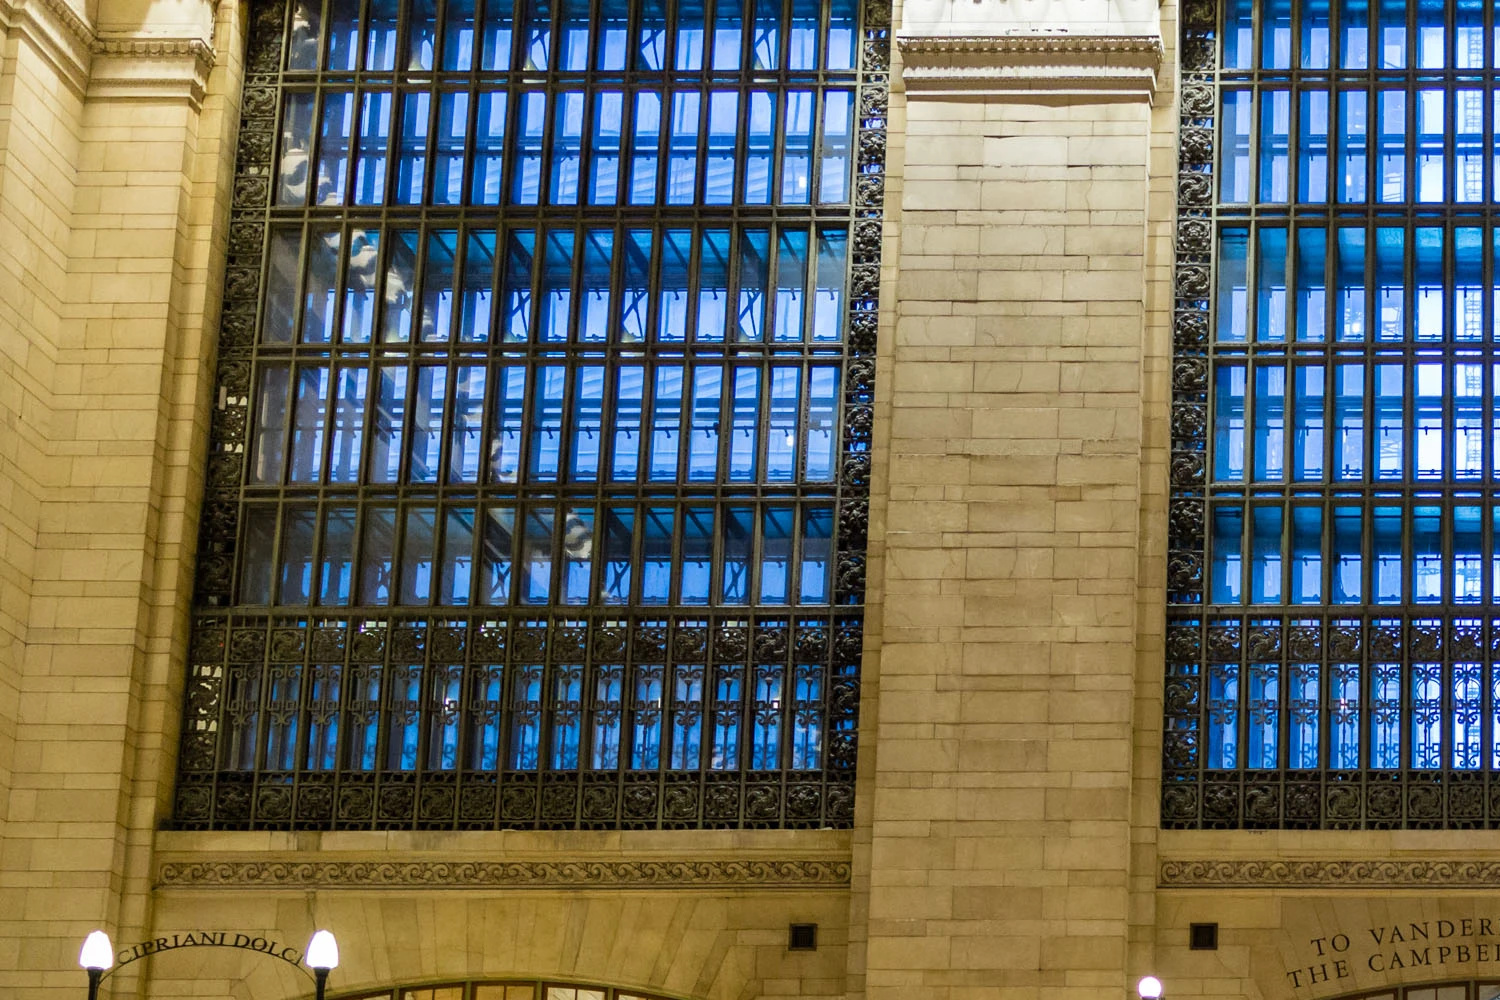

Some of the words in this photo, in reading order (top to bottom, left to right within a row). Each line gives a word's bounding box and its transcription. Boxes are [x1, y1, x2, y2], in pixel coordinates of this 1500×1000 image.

[116, 932, 225, 966] CIPRIANI
[1311, 933, 1350, 956] TO
[1287, 959, 1349, 989] THE
